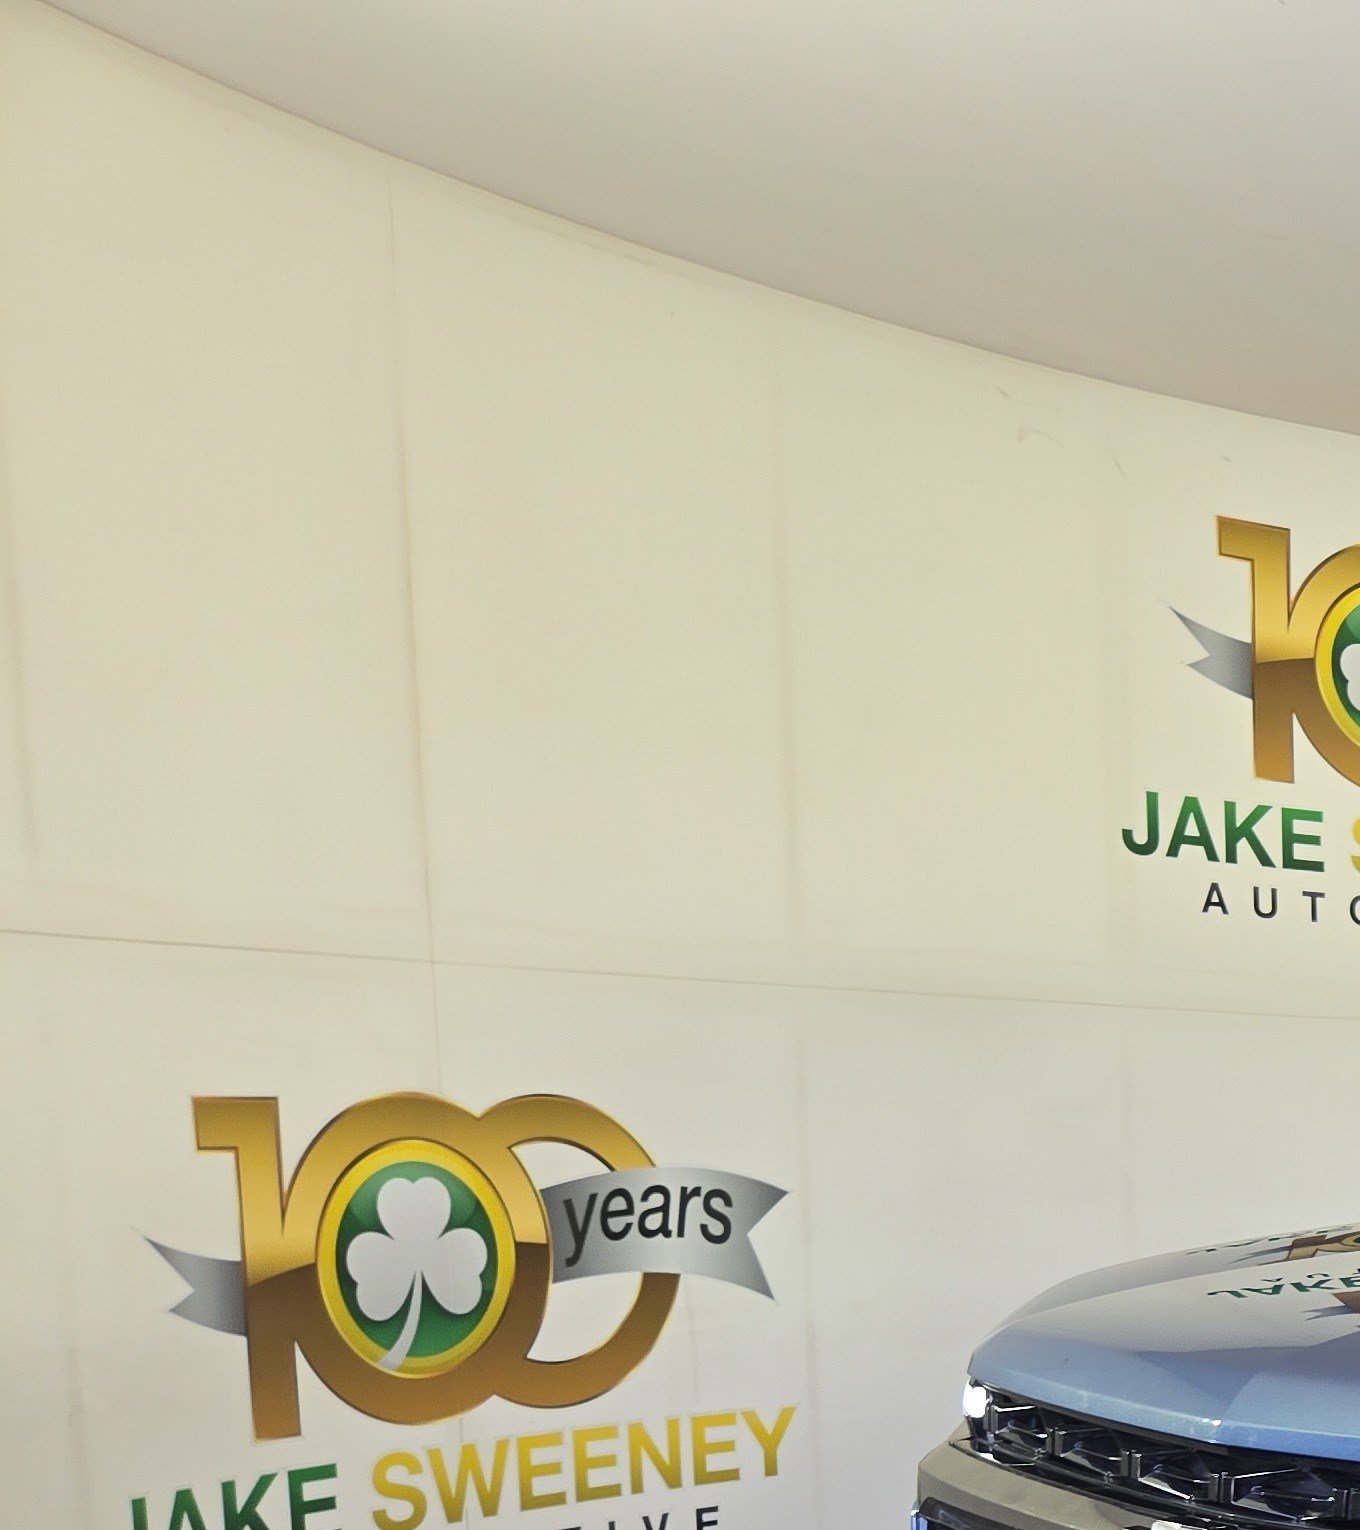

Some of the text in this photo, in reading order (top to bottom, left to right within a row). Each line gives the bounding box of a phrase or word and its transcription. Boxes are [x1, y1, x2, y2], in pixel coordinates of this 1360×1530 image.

[1121, 790, 1324, 873] JAKE
[190, 1091, 682, 1442] 100
[562, 1184, 734, 1267] years
